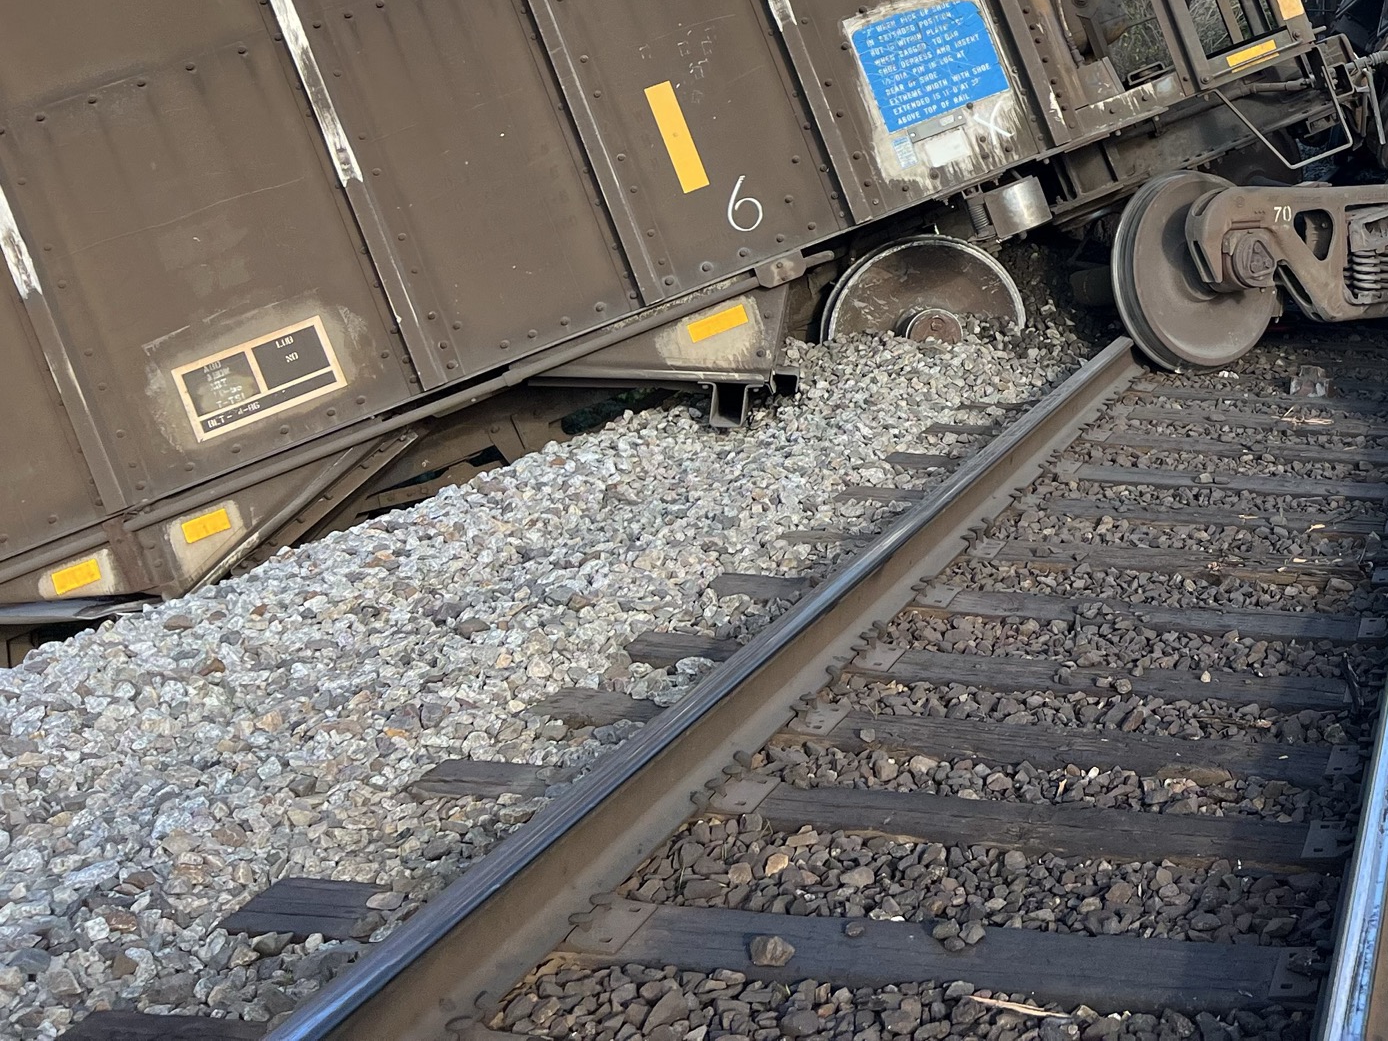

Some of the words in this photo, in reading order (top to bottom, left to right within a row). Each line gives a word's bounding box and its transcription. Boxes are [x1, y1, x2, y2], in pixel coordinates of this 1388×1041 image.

[870, 46, 884, 56] BUT
[926, 25, 947, 35] PLATE
[874, 54, 895, 66] WHEN
[932, 36, 942, 45] TO
[878, 65, 897, 74] SHOE
[900, 51, 932, 68] DEPRESS
[936, 45, 950, 54] AND
[954, 34, 979, 47] INSERT
[912, 65, 925, 74] PIN
[956, 50, 964, 58] AT
[885, 84, 904, 96] REAR
[889, 89, 922, 106] EXTREME
[926, 79, 948, 92] WIDTH
[952, 71, 970, 82] WITH
[972, 63, 991, 74] SHOE
[893, 97, 930, 115] EXTENDED
[932, 92, 941, 100] IS
[960, 82, 969, 90] AT
[898, 111, 920, 124] ABOVE
[923, 104, 937, 114] TOP
[940, 100, 949, 109] OF
[727, 175, 763, 232] 6
[1273, 205, 1292, 223] 70
